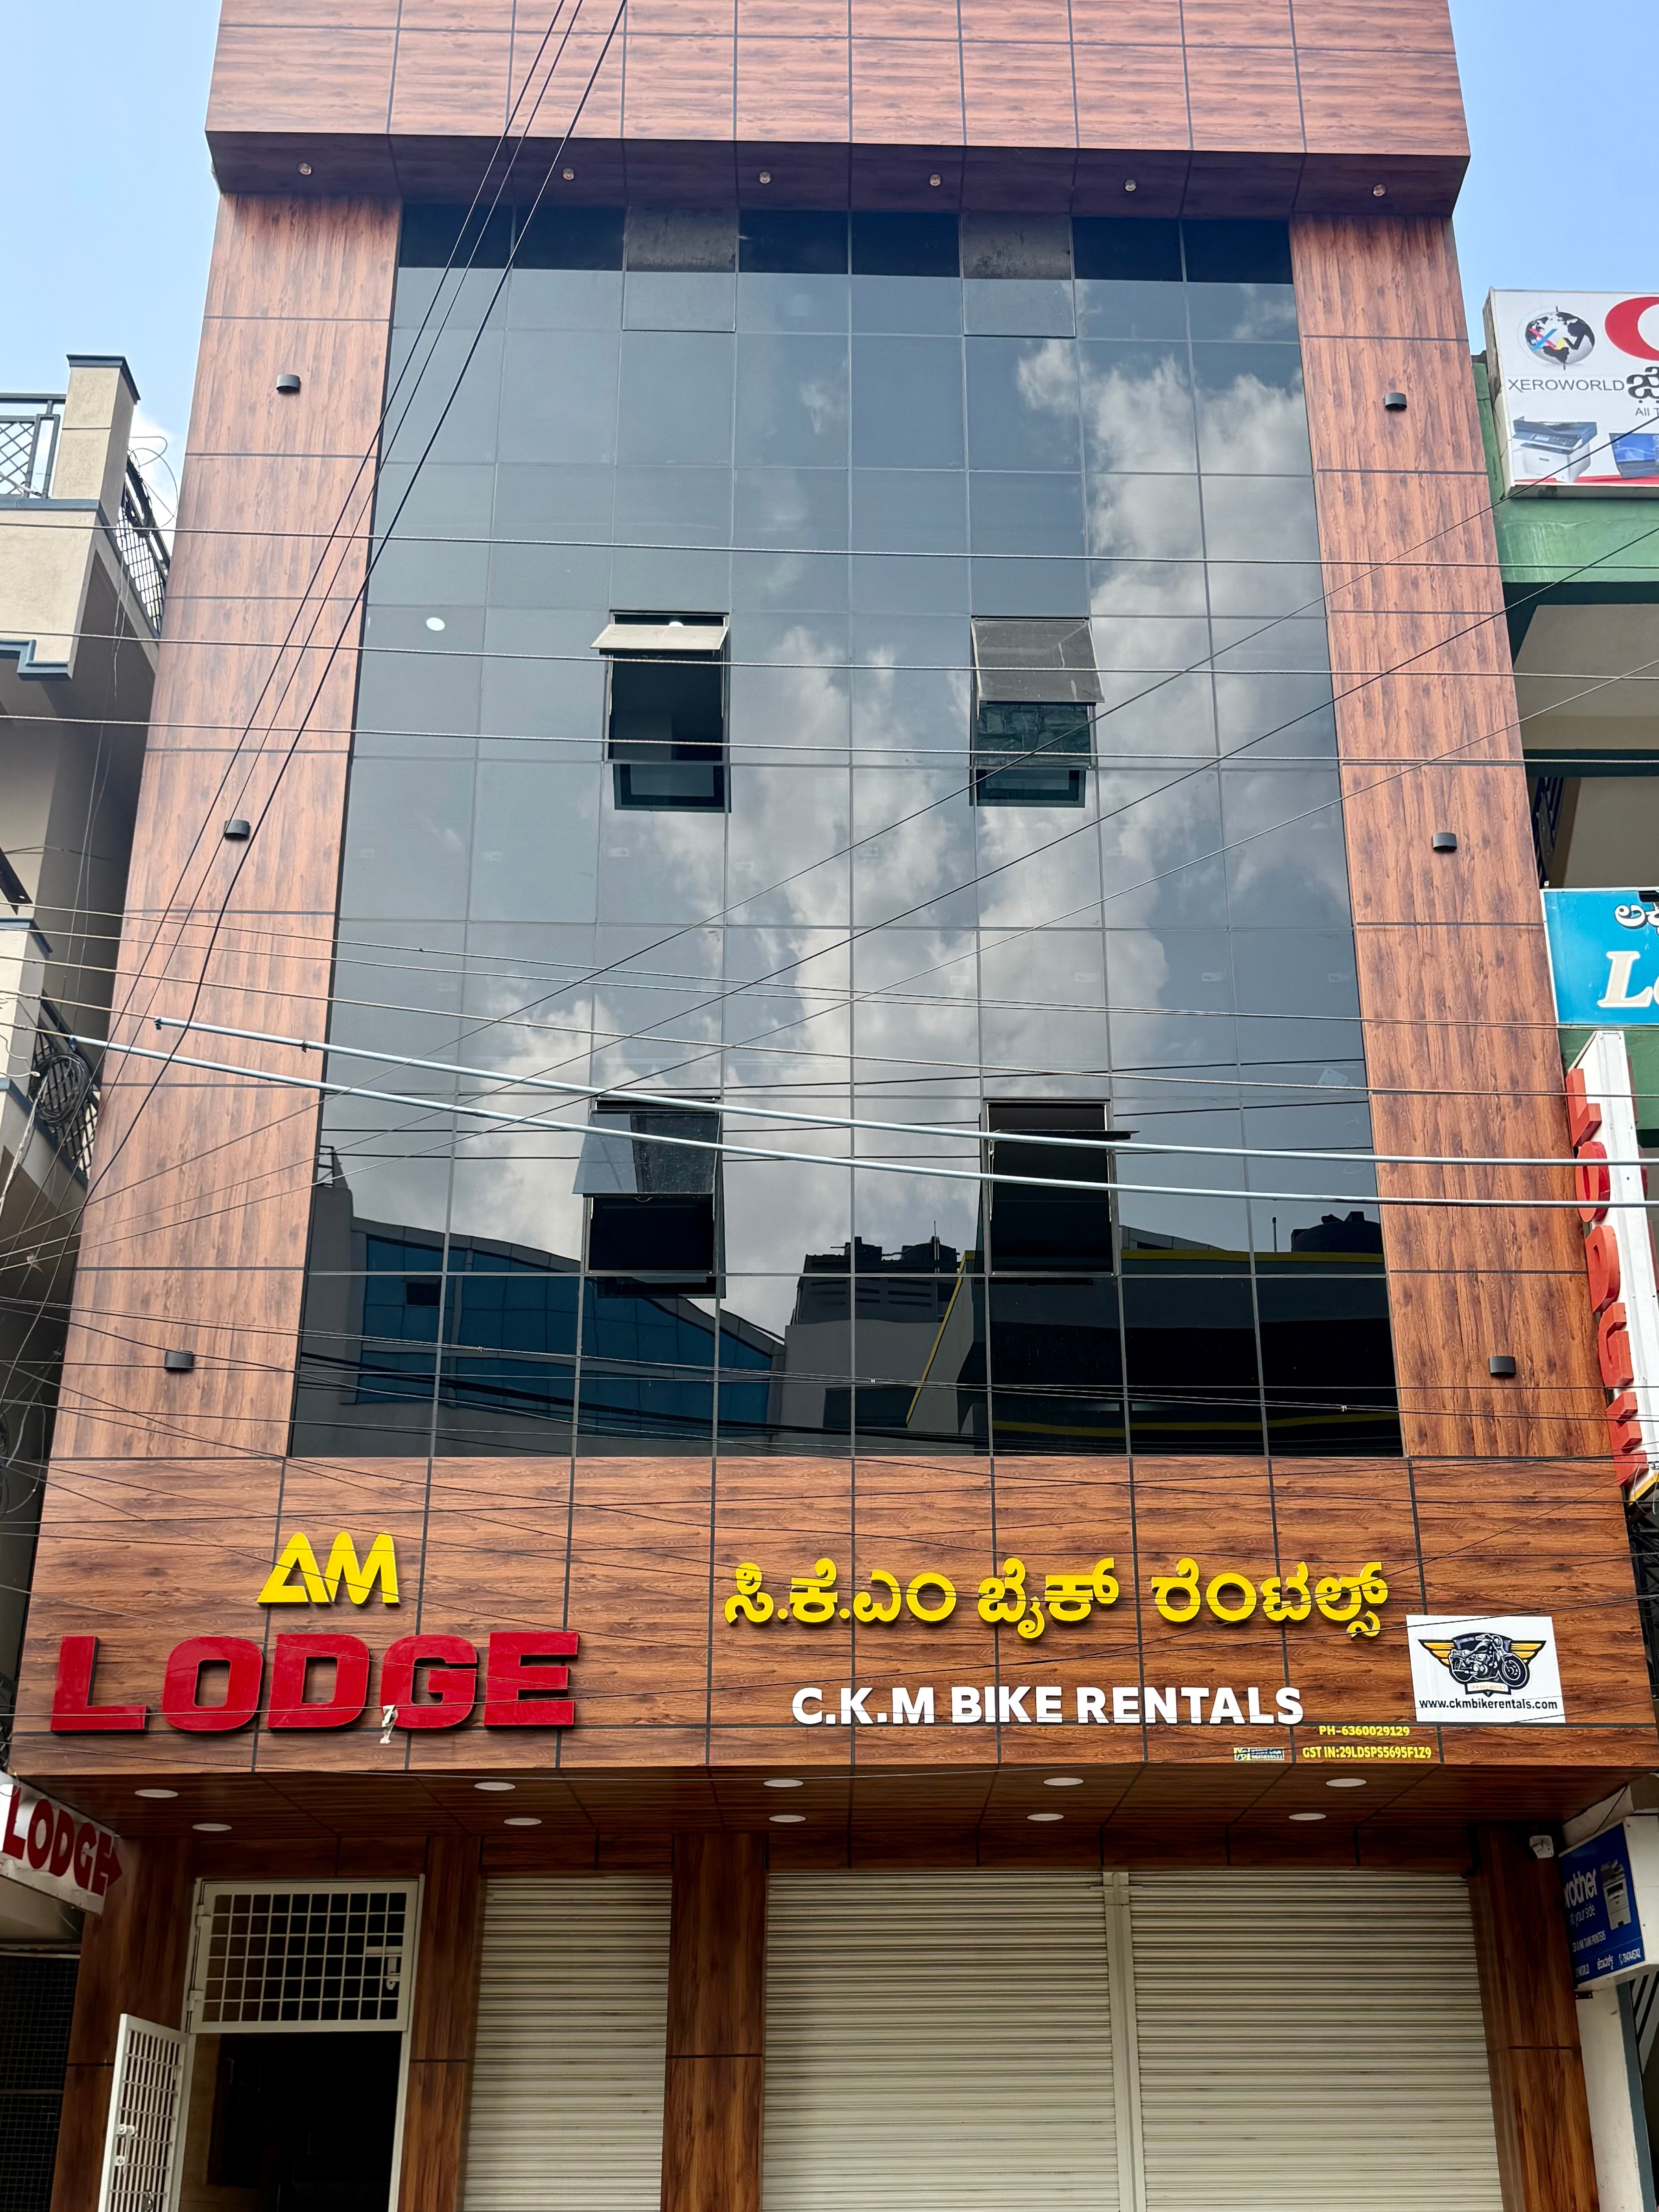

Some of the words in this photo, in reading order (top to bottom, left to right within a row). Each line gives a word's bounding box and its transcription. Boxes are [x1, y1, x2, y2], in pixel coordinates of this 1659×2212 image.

[1508, 379, 1625, 393] XEROWORLD
[1565, 1067, 1648, 1487] LODGE
[257, 1531, 401, 1605] AM
[724, 1558, 957, 1624] ಸಿ.ಕೆ.ಎಂ
[977, 1557, 1119, 1639] ಬೈಕ್
[50, 1631, 580, 1733] LODGE
[791, 1686, 935, 1725] C.K.M
[951, 1685, 1062, 1724] BIKE
[1076, 1686, 1303, 1725] RENTALS
[1419, 1698, 1558, 1709] www.ckmbikerentals.com
[1319, 1725, 1411, 1736] PH-6360029129
[1302, 1746, 1322, 1759] GST
[3, 1784, 113, 1897] LODGE
[1563, 1868, 1597, 1909] rother
[1585, 1903, 1595, 1919] side
